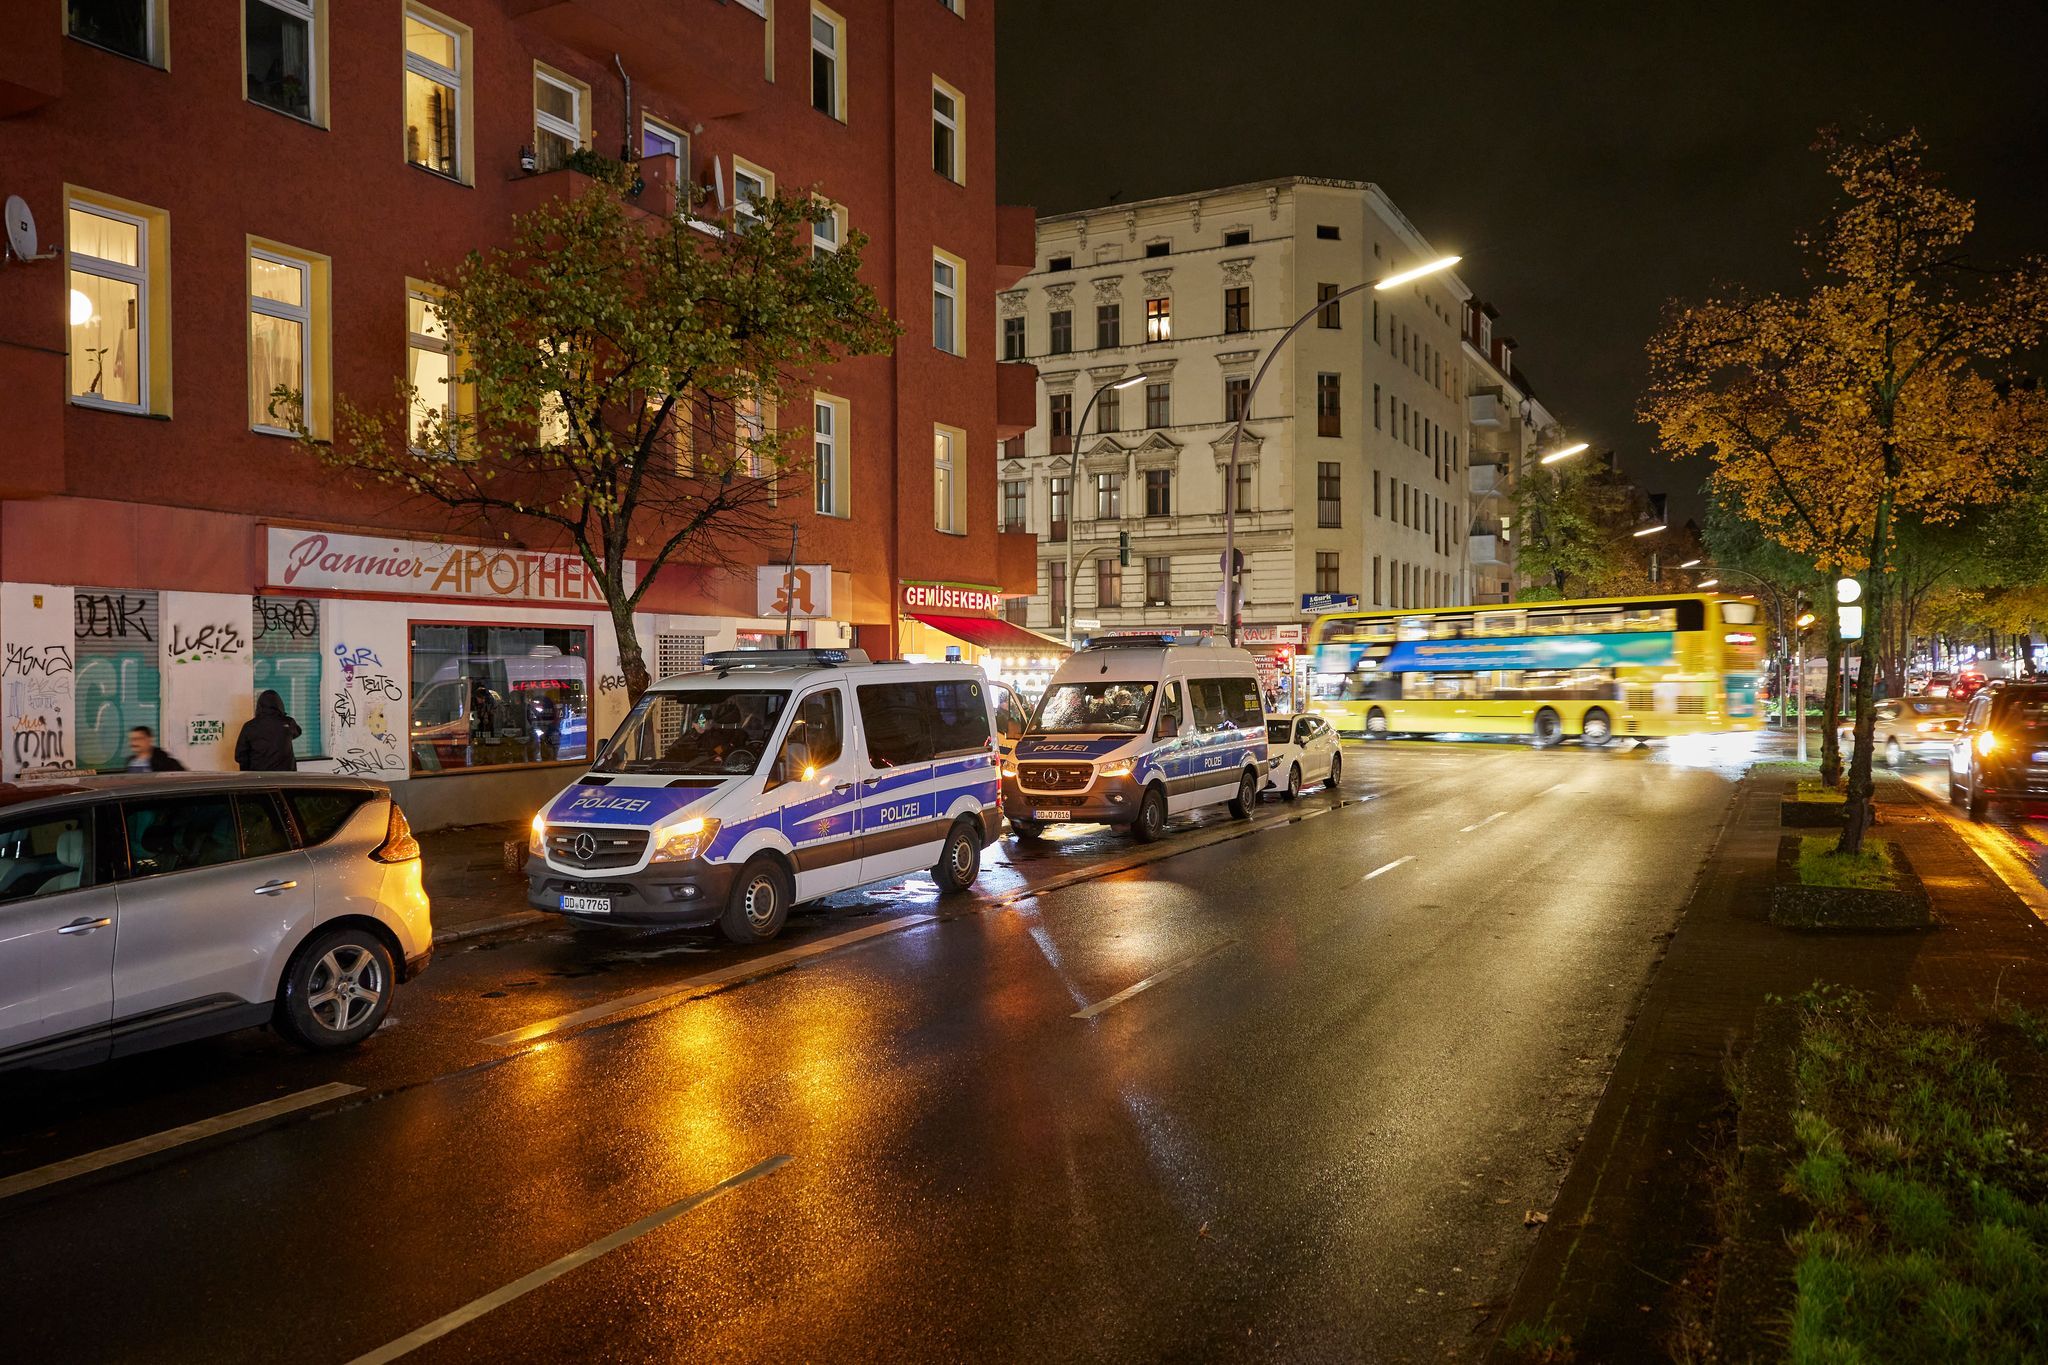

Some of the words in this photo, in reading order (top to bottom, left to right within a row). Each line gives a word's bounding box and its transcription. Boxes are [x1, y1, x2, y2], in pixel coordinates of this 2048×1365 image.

[284, 534, 608, 601] Pannier-APOTHEK
[906, 584, 999, 611] GEMÜSEKEBAP
[1033, 744, 1089, 752] POLIZEI
[1204, 756, 1223, 768] POLIZEI
[569, 797, 651, 812] POLIZEI
[880, 802, 920, 823] POLIZEI
[564, 897, 575, 909] DD
[586, 899, 609, 911] 7765
